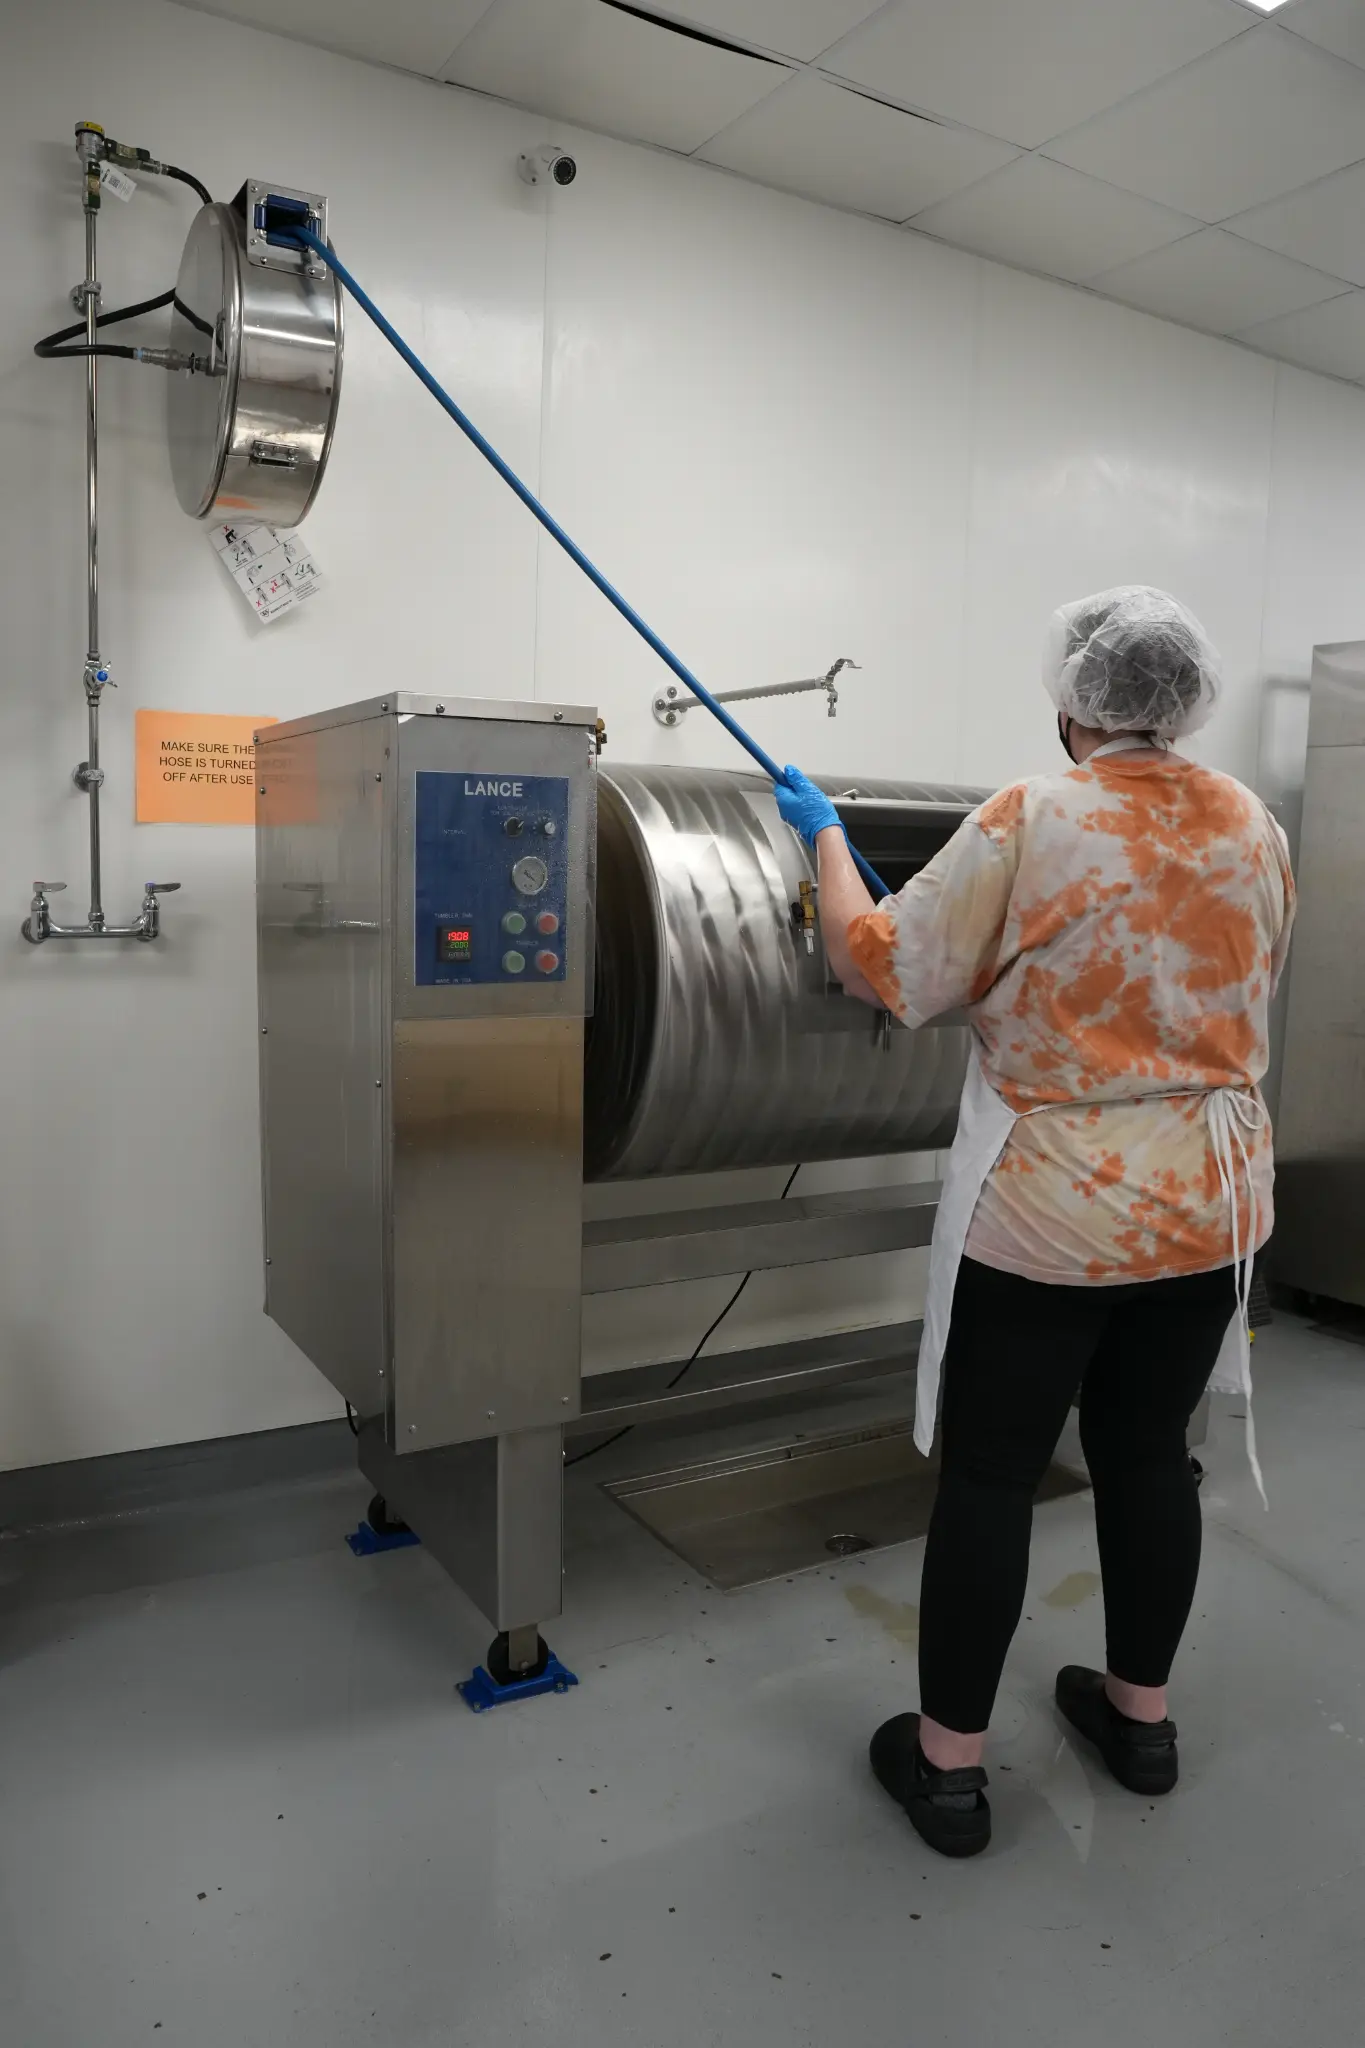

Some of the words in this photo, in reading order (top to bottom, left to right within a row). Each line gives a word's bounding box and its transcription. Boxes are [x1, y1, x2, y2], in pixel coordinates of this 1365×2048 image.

[161, 741, 194, 752] MAKE
[198, 743, 229, 753] SURE
[233, 744, 255, 755] THE
[159, 757, 192, 767] HOSE
[196, 758, 206, 768] IS
[210, 759, 256, 770] TURNED
[163, 772, 186, 782] OFF
[189, 773, 227, 784] AFTER
[230, 775, 253, 785] USE
[464, 780, 523, 797] LANCE
